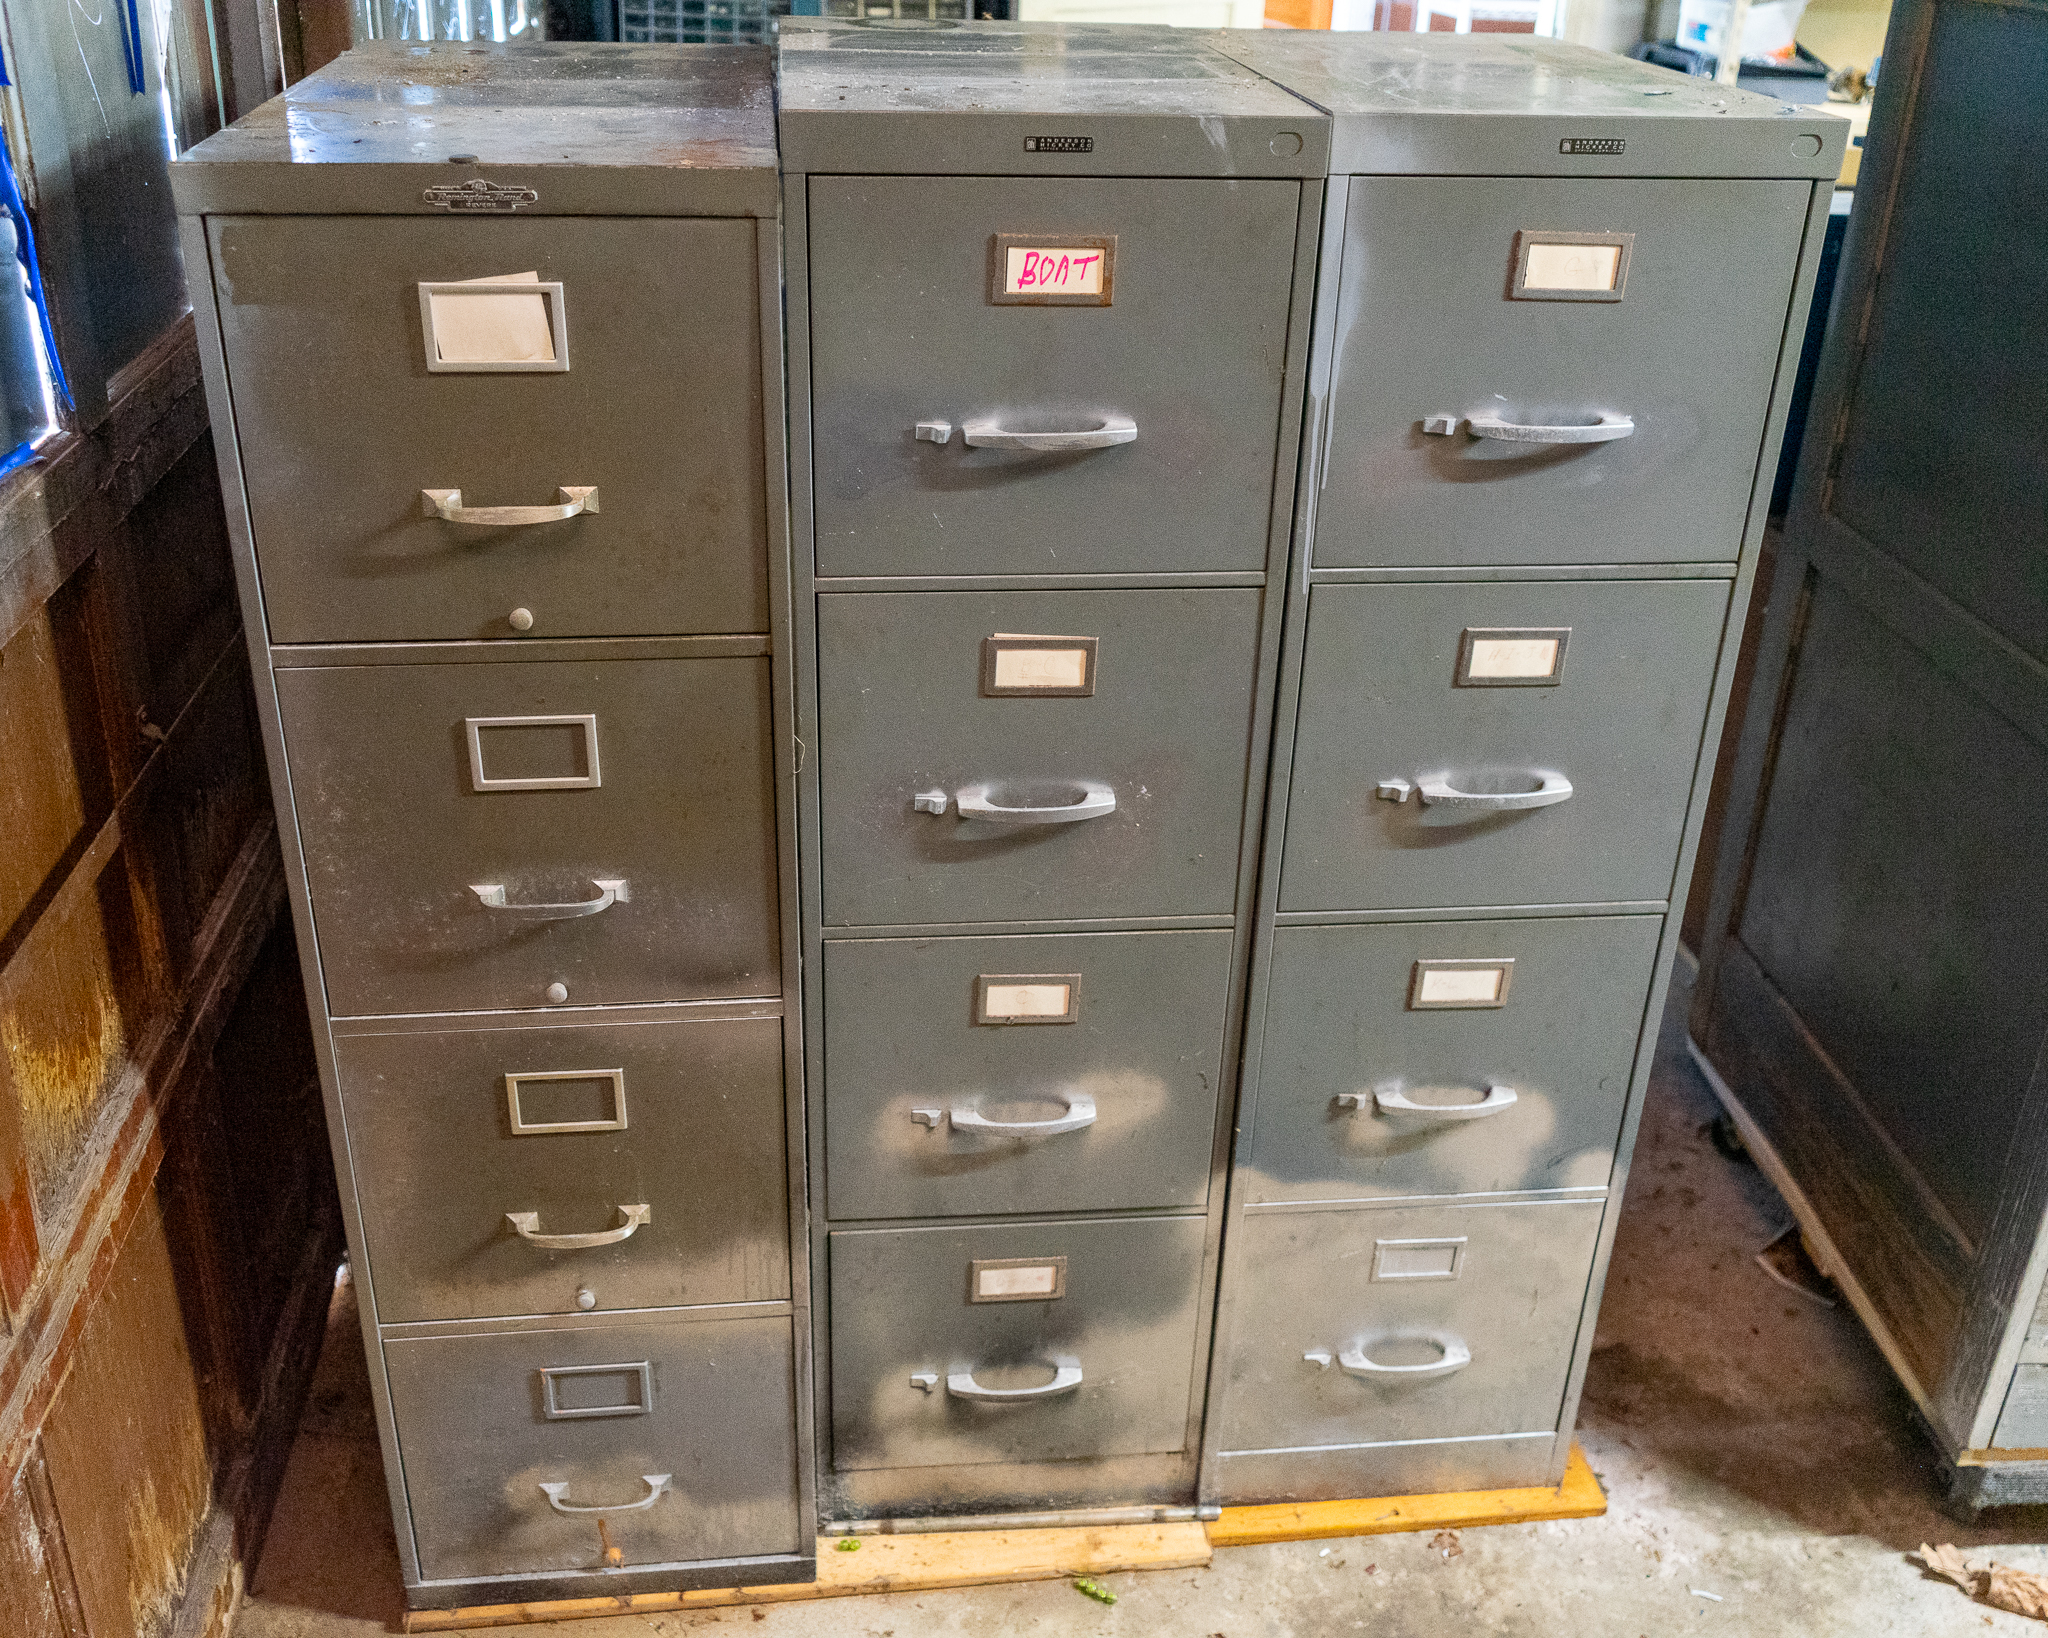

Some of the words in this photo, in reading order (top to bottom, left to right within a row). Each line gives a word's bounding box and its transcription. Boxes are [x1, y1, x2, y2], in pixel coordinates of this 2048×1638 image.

[437, 192, 493, 202] Remington
[494, 192, 524, 201] Rand
[1017, 251, 1100, 289] BOAT
